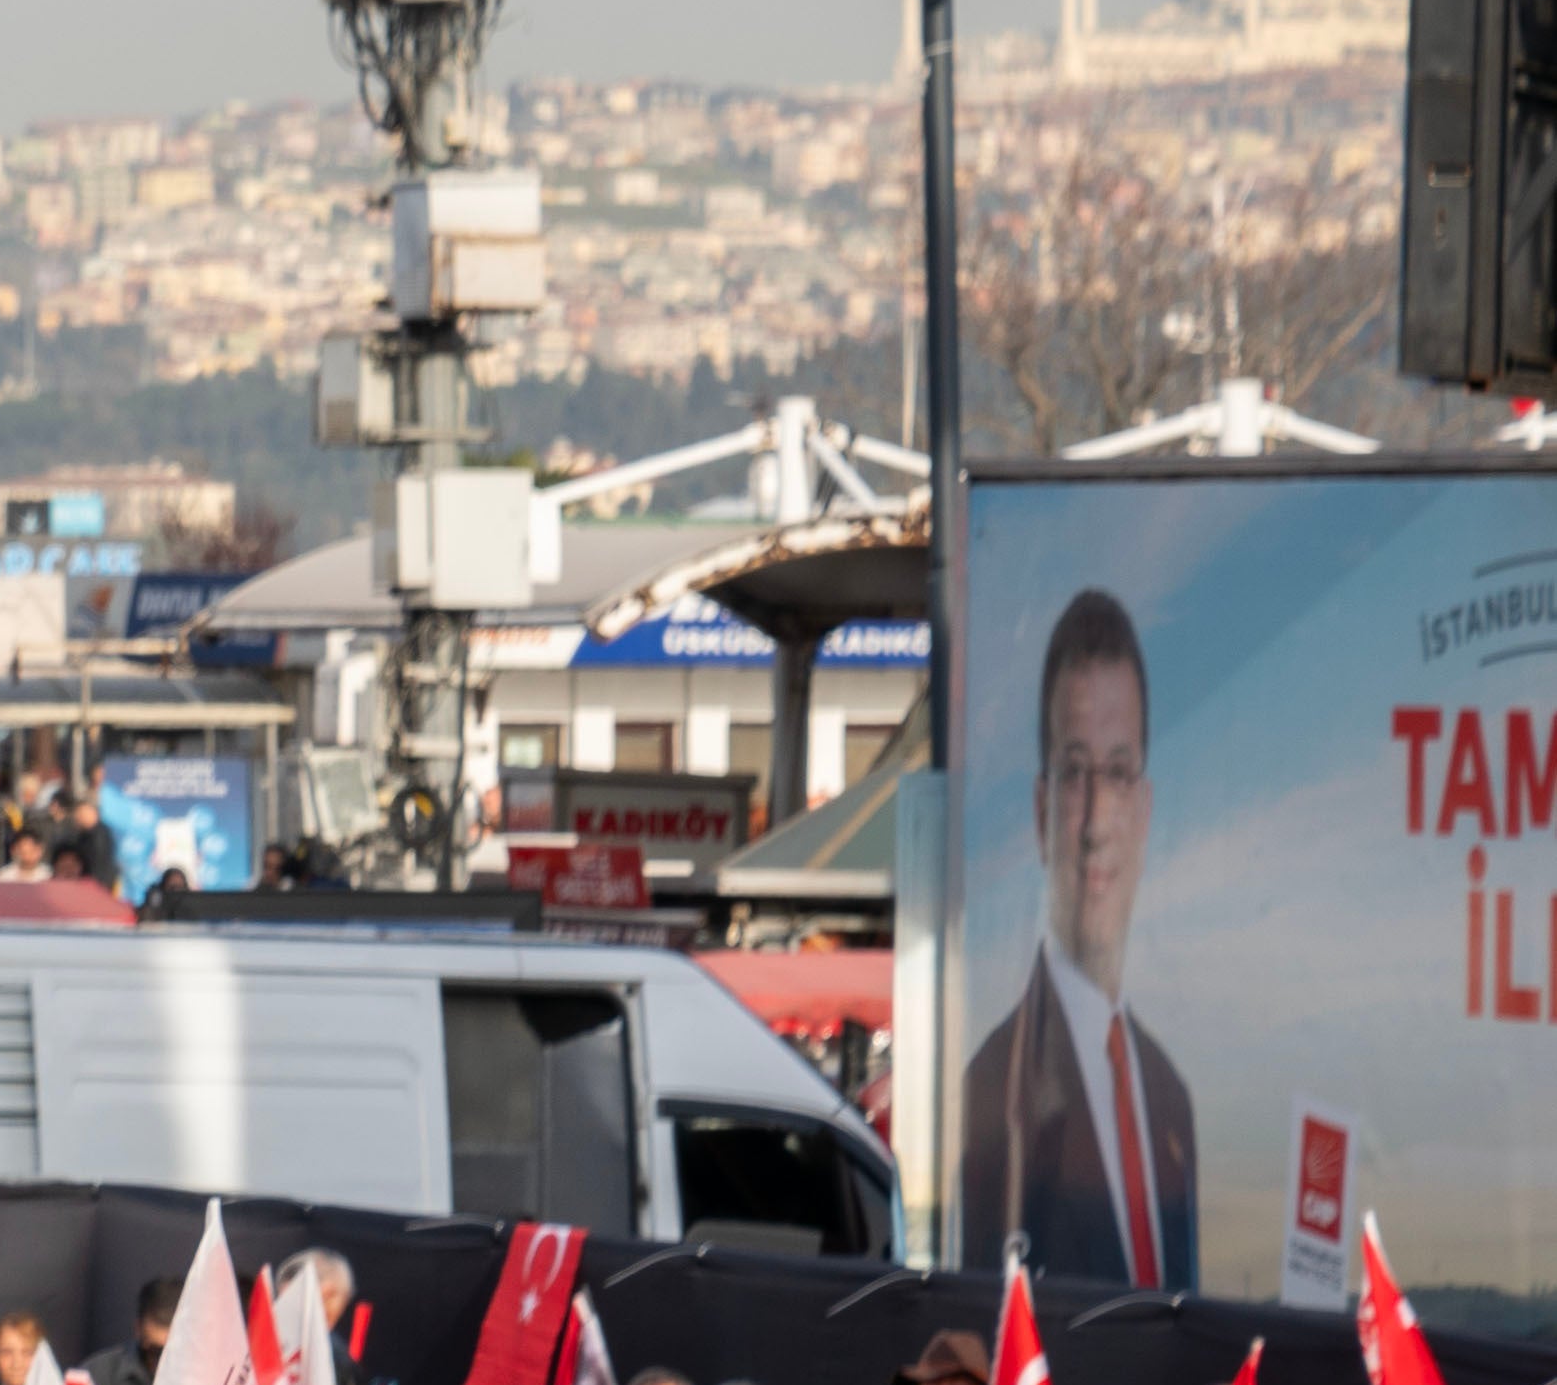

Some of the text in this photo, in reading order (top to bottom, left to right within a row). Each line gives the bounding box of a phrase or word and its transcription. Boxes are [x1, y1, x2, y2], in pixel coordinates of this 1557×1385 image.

[661, 619, 932, 658] ÜSKÜDA KADIKÖ
[1391, 705, 1557, 841] TAM
[574, 803, 730, 842] KADIKÖY
